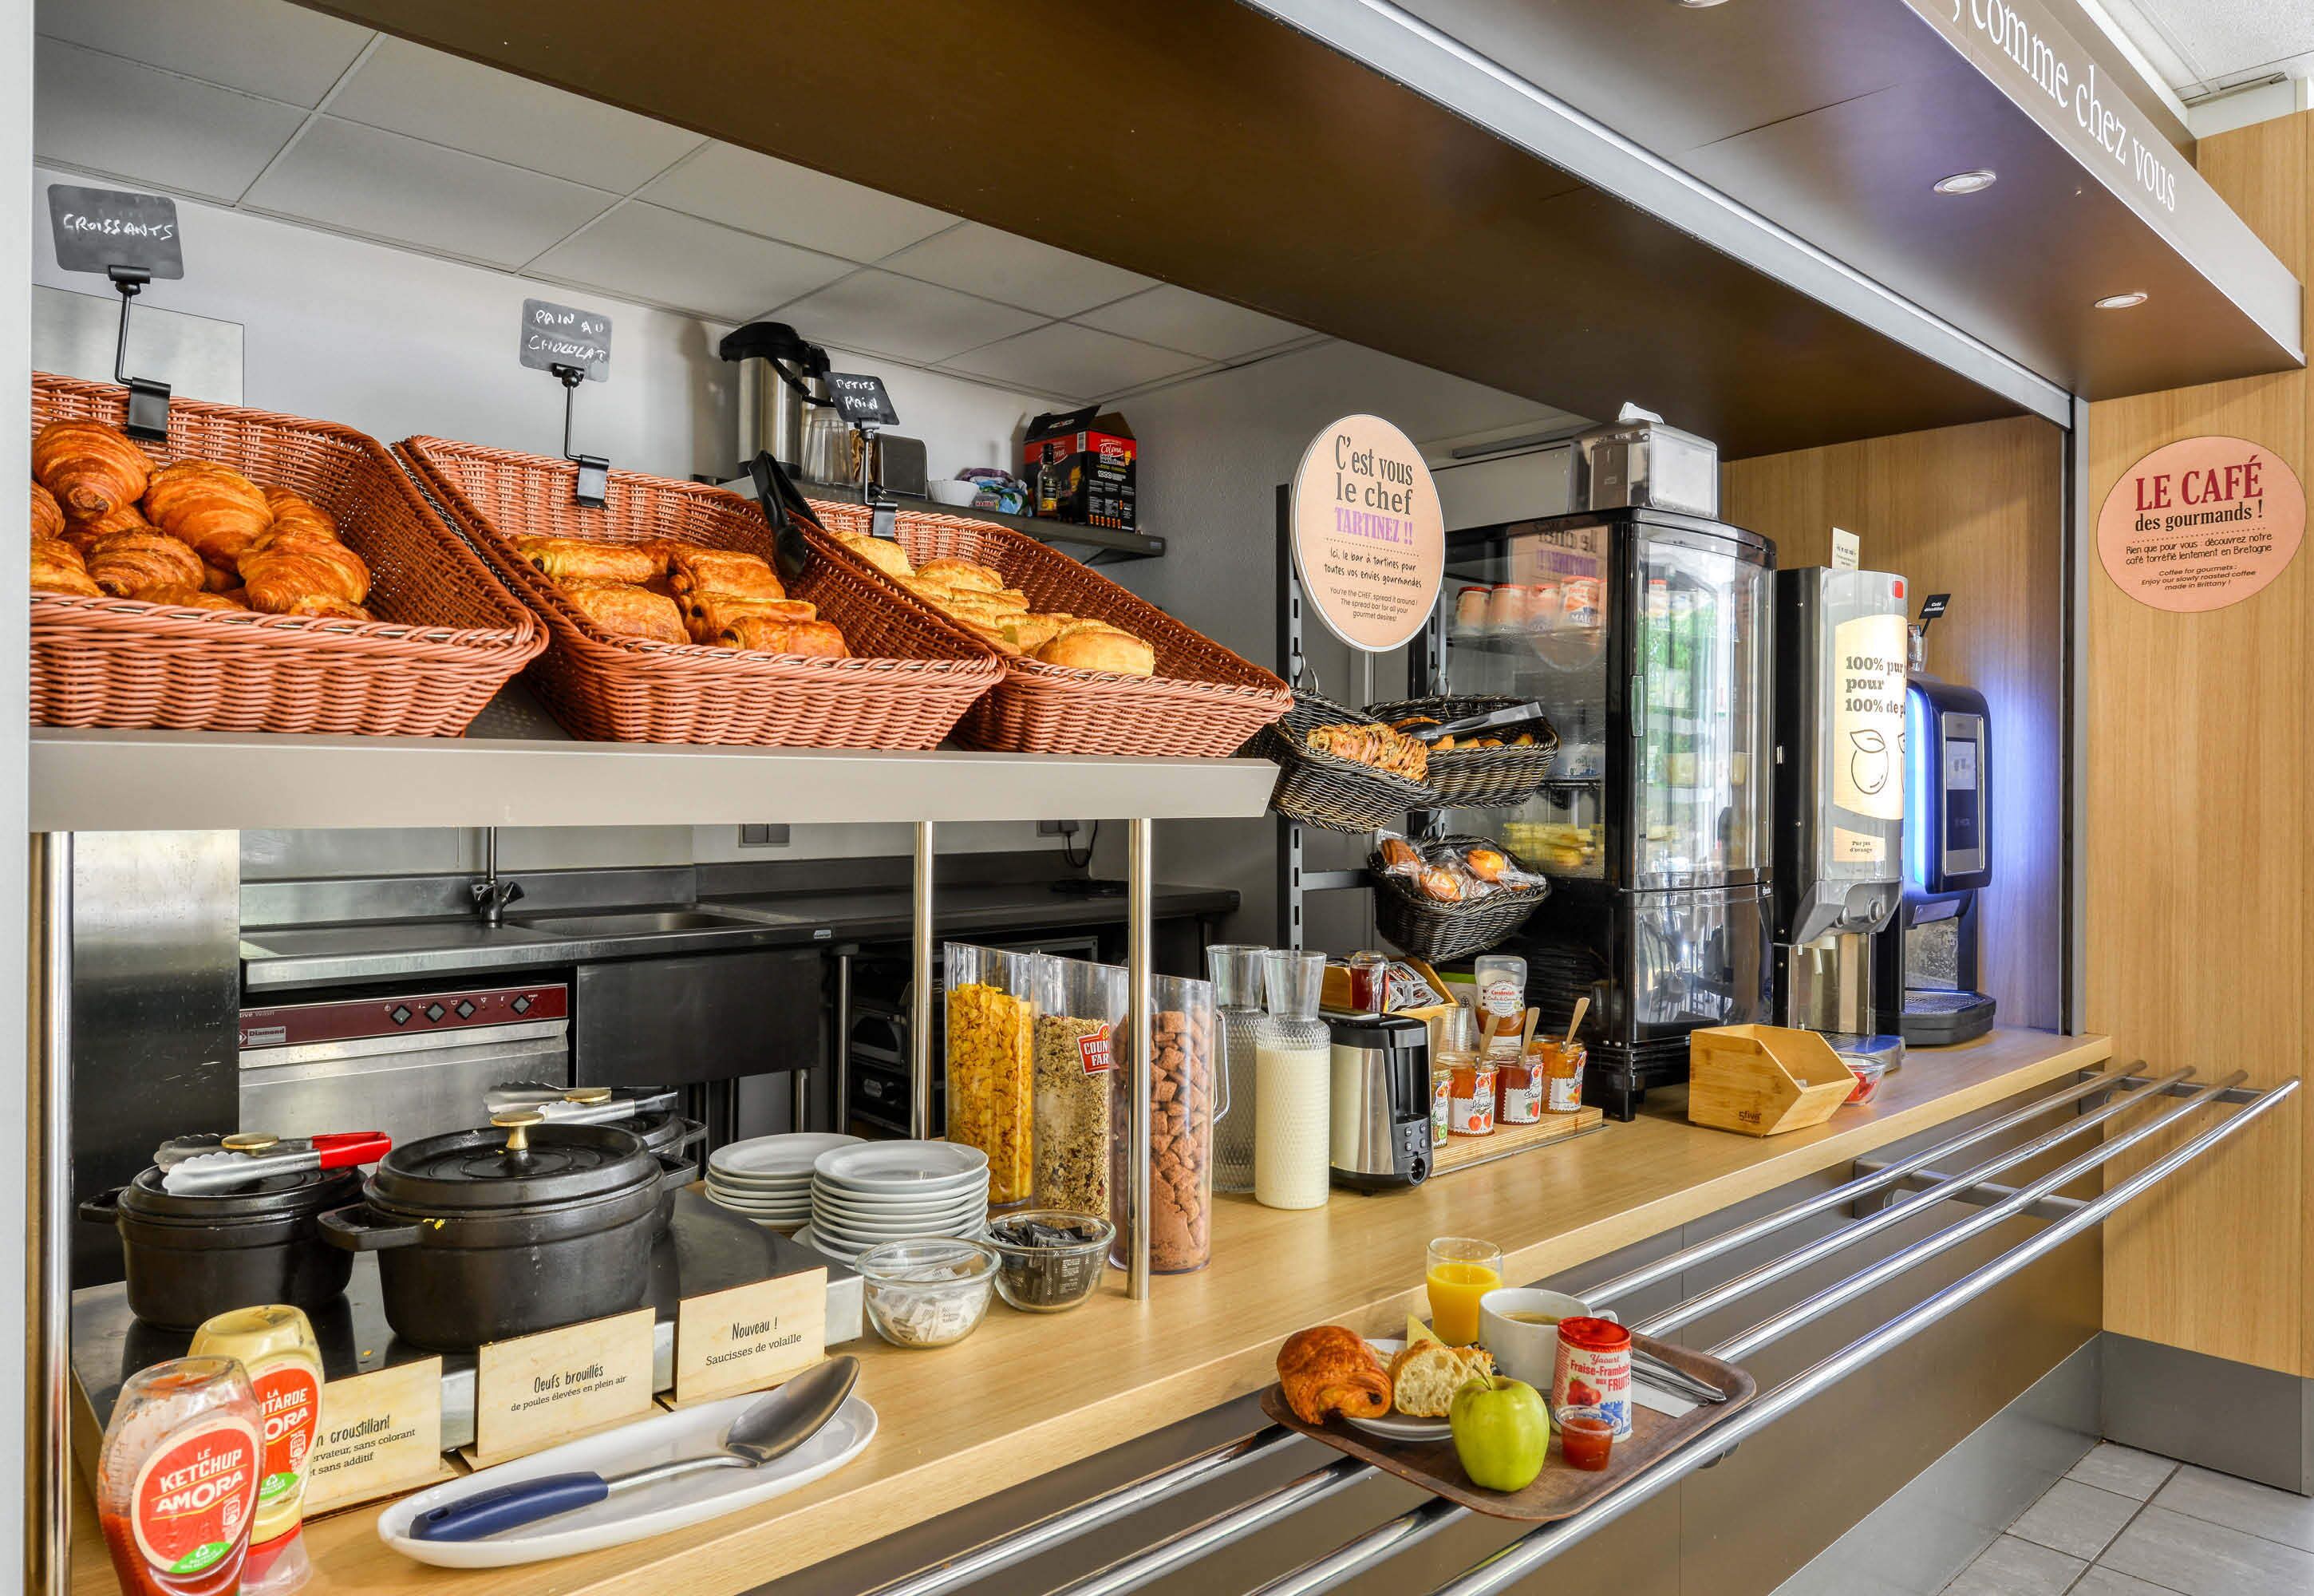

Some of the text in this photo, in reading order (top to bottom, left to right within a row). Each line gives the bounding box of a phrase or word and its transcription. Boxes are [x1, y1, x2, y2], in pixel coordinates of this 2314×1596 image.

[1972, 0, 2175, 211] comme chez vous
[64, 213, 173, 240] CROISSANTS
[535, 310, 604, 334] PAIN AU
[1335, 435, 1413, 486] C'est vous
[1336, 472, 1413, 515] le chef
[2134, 454, 2264, 512] LE CAFÉ
[1335, 507, 1400, 543] TARTINEZ
[2135, 514, 2161, 531] des
[2165, 501, 2253, 532] gourmands
[2126, 546, 2142, 555] Rien
[2144, 546, 2158, 555] que
[2160, 543, 2177, 555] pour
[2205, 536, 2246, 547] découvrez
[2249, 533, 2273, 543] notre
[2126, 555, 2143, 565] café
[2179, 549, 2218, 560] lentement
[2234, 543, 2273, 555] Bretagne
[1342, 550, 1349, 561] le
[1351, 551, 1364, 563] bar
[1373, 556, 1400, 569] tartines
[1401, 563, 1416, 572] pour
[2196, 565, 2233, 575] gourmets
[1324, 563, 1422, 588] toutes vos envies gourmandes
[2176, 575, 2198, 583] slowly
[2197, 580, 2226, 589] Brittany
[1352, 601, 1371, 610] spread
[1373, 594, 1392, 603] spread
[1352, 610, 1376, 619] gourmet
[1846, 655, 1884, 671] 100%
[1887, 662, 1904, 676] pur
[1846, 678, 1885, 693] pour
[1845, 697, 1883, 713] 100%
[1886, 700, 1898, 713] de
[249, 1028, 285, 1037] Diamond
[1084, 1040, 1110, 1055] COUN
[1091, 1053, 1110, 1066] FAR
[732, 1320, 770, 1341] Nouveau
[705, 1333, 802, 1367] Saucisses de volaille
[1589, 1353, 1620, 1365] Yaourt
[534, 1363, 605, 1394] Oeufs brouillés
[267, 1389, 279, 1399] LA
[511, 1375, 626, 1412] de poules élevées en plein air
[330, 1414, 390, 1444] croustillant
[353, 1440, 376, 1452] sans
[378, 1429, 416, 1445] colorant
[197, 1448, 211, 1461] LE
[318, 1464, 342, 1476] sans
[344, 1452, 374, 1468] additif
[160, 1448, 243, 1494] KETCHUP
[156, 1470, 243, 1513] AMORA
